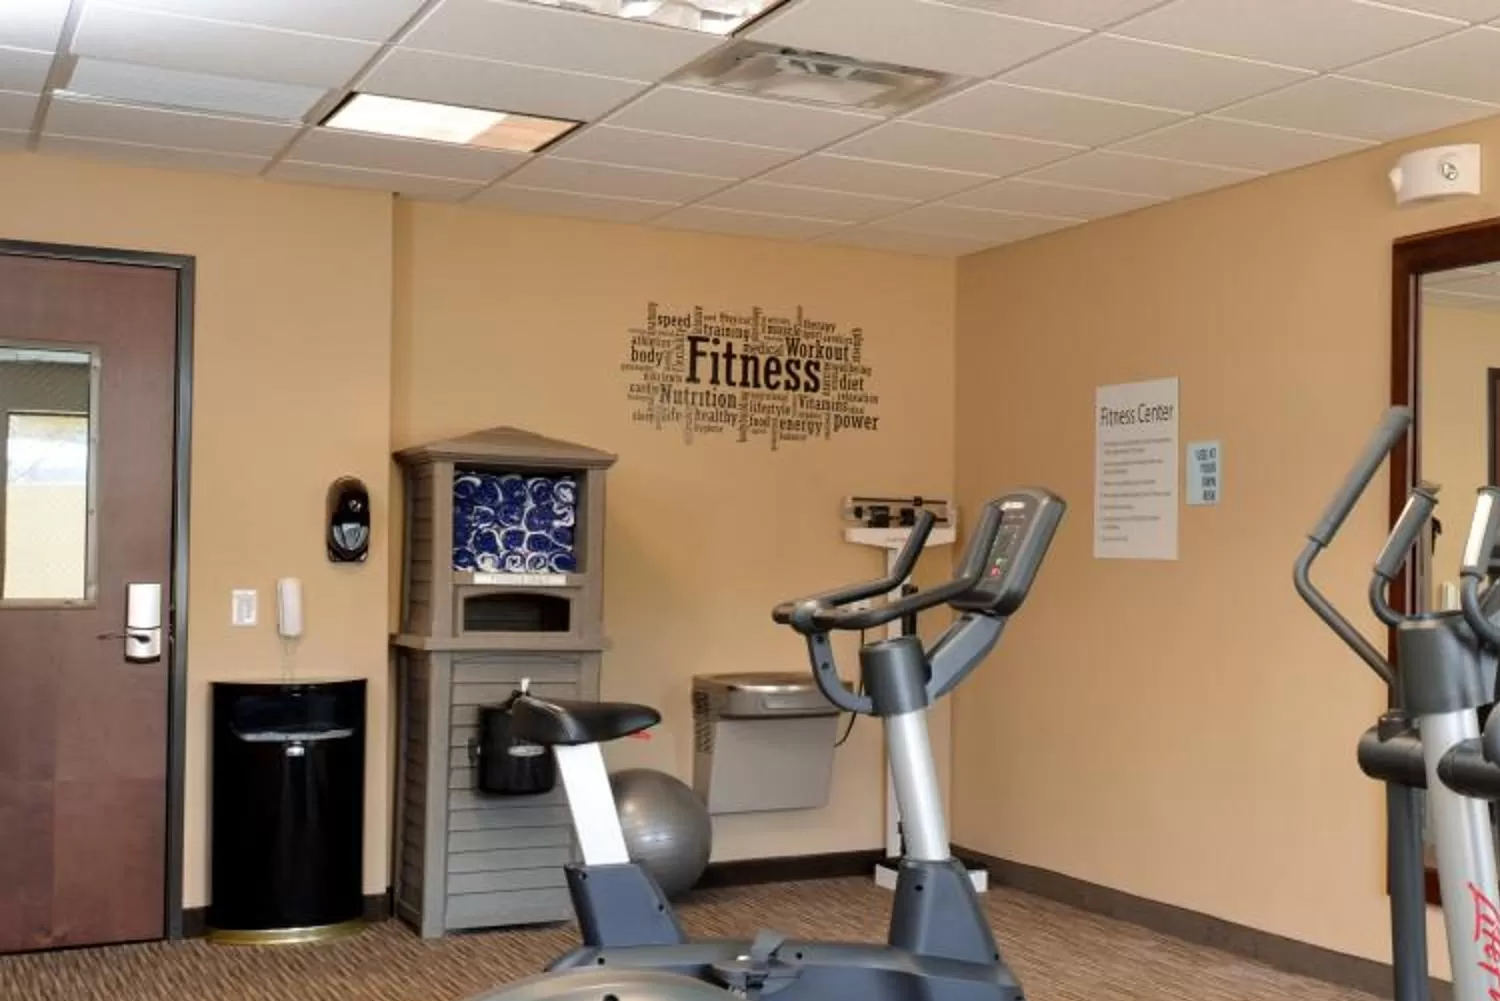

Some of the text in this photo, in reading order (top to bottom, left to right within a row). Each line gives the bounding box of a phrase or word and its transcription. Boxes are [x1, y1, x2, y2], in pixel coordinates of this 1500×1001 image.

[657, 312, 690, 329] speed
[631, 346, 663, 366] body
[785, 335, 849, 362] Workout
[685, 335, 821, 393] Fitness
[840, 373, 865, 391] diet
[659, 384, 737, 408] Nutrition
[834, 413, 879, 432] power
[1100, 403, 1174, 428] Fitness Center
[780, 418, 822, 436] energy
